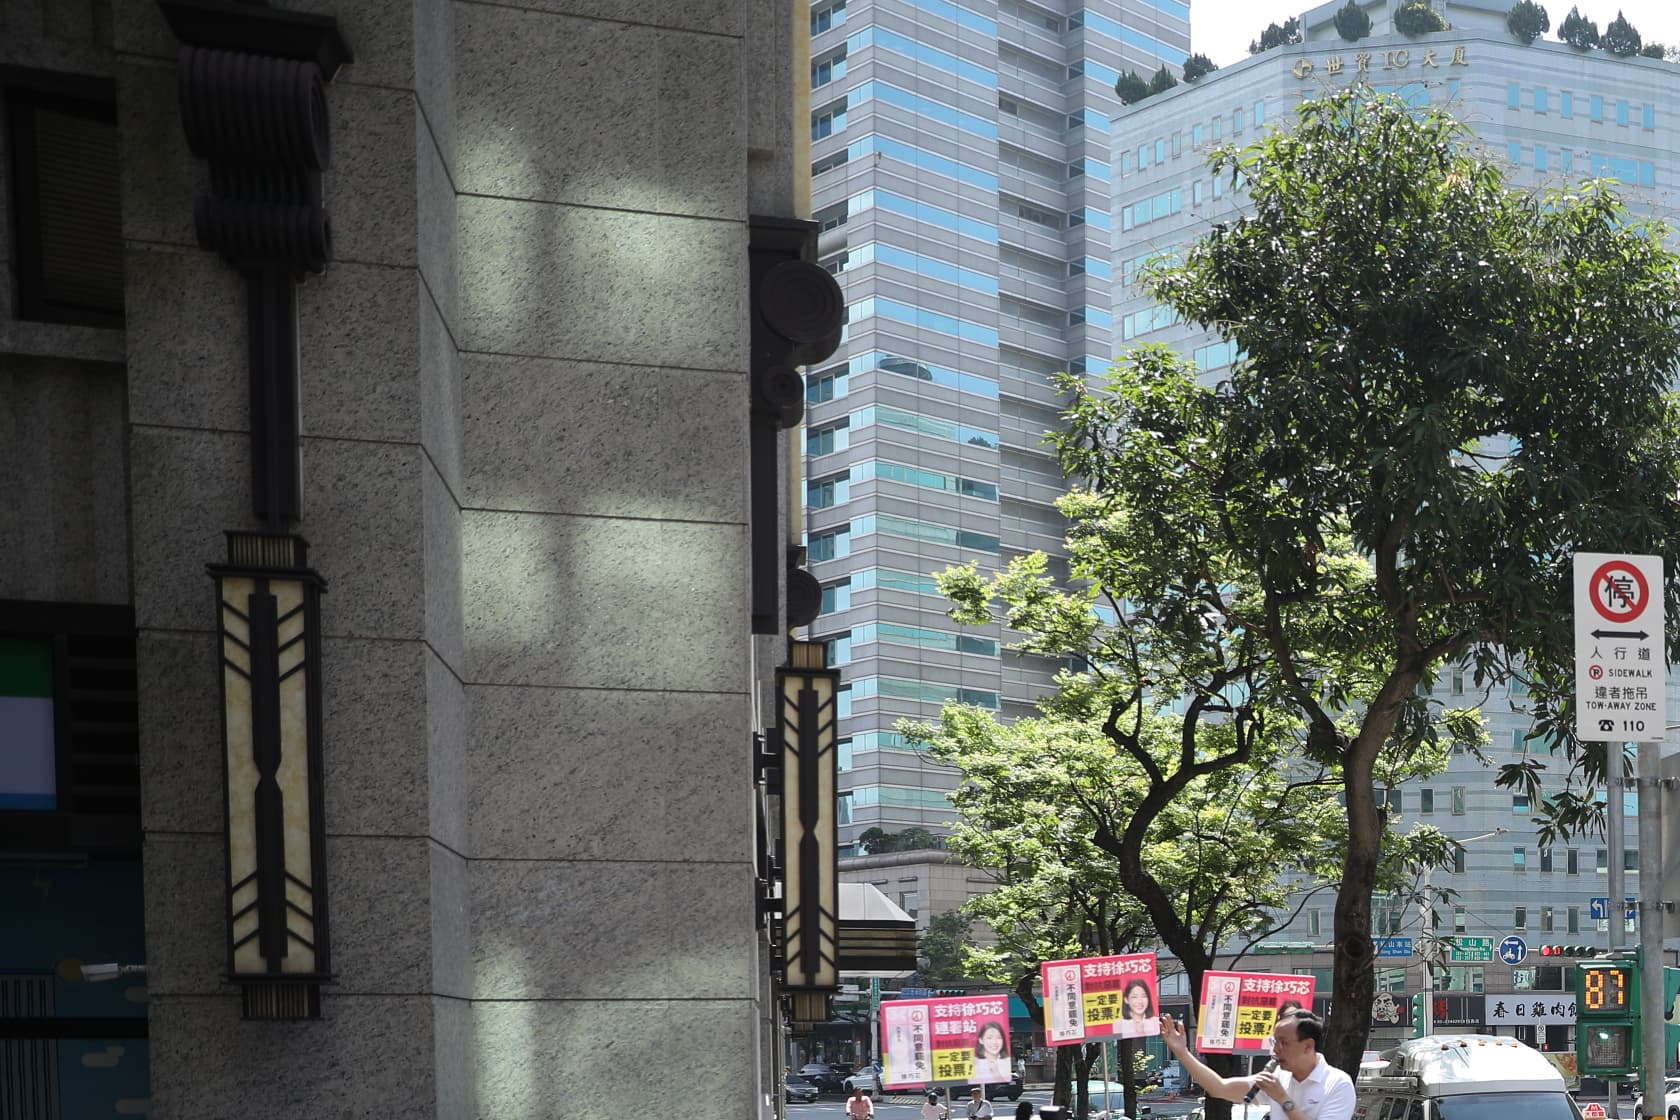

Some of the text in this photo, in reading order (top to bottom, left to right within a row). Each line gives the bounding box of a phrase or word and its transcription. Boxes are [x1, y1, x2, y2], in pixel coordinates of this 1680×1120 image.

[1590, 647, 1650, 661] 人行道
[1609, 669, 1652, 678] SIDEWALK
[1595, 686, 1648, 700] 違者拖吊
[1586, 701, 1656, 711] TOW-AWAY ZONE
[1623, 721, 1645, 731] 110
[1455, 938, 1490, 946] 松山路
[1084, 959, 1152, 978] 支持徐巧芯
[1243, 978, 1311, 995] 支持徐巧芯
[1585, 970, 1624, 1008] 87
[1086, 994, 1118, 1005] 一定要
[934, 1001, 1004, 1017] 支持徐巧芯
[1088, 1007, 1120, 1022] 投票!
[1240, 1010, 1272, 1020] 一定要
[1239, 1022, 1272, 1036] 投票!
[938, 1051, 971, 1062] 一定要
[939, 1064, 973, 1078] 投票!
